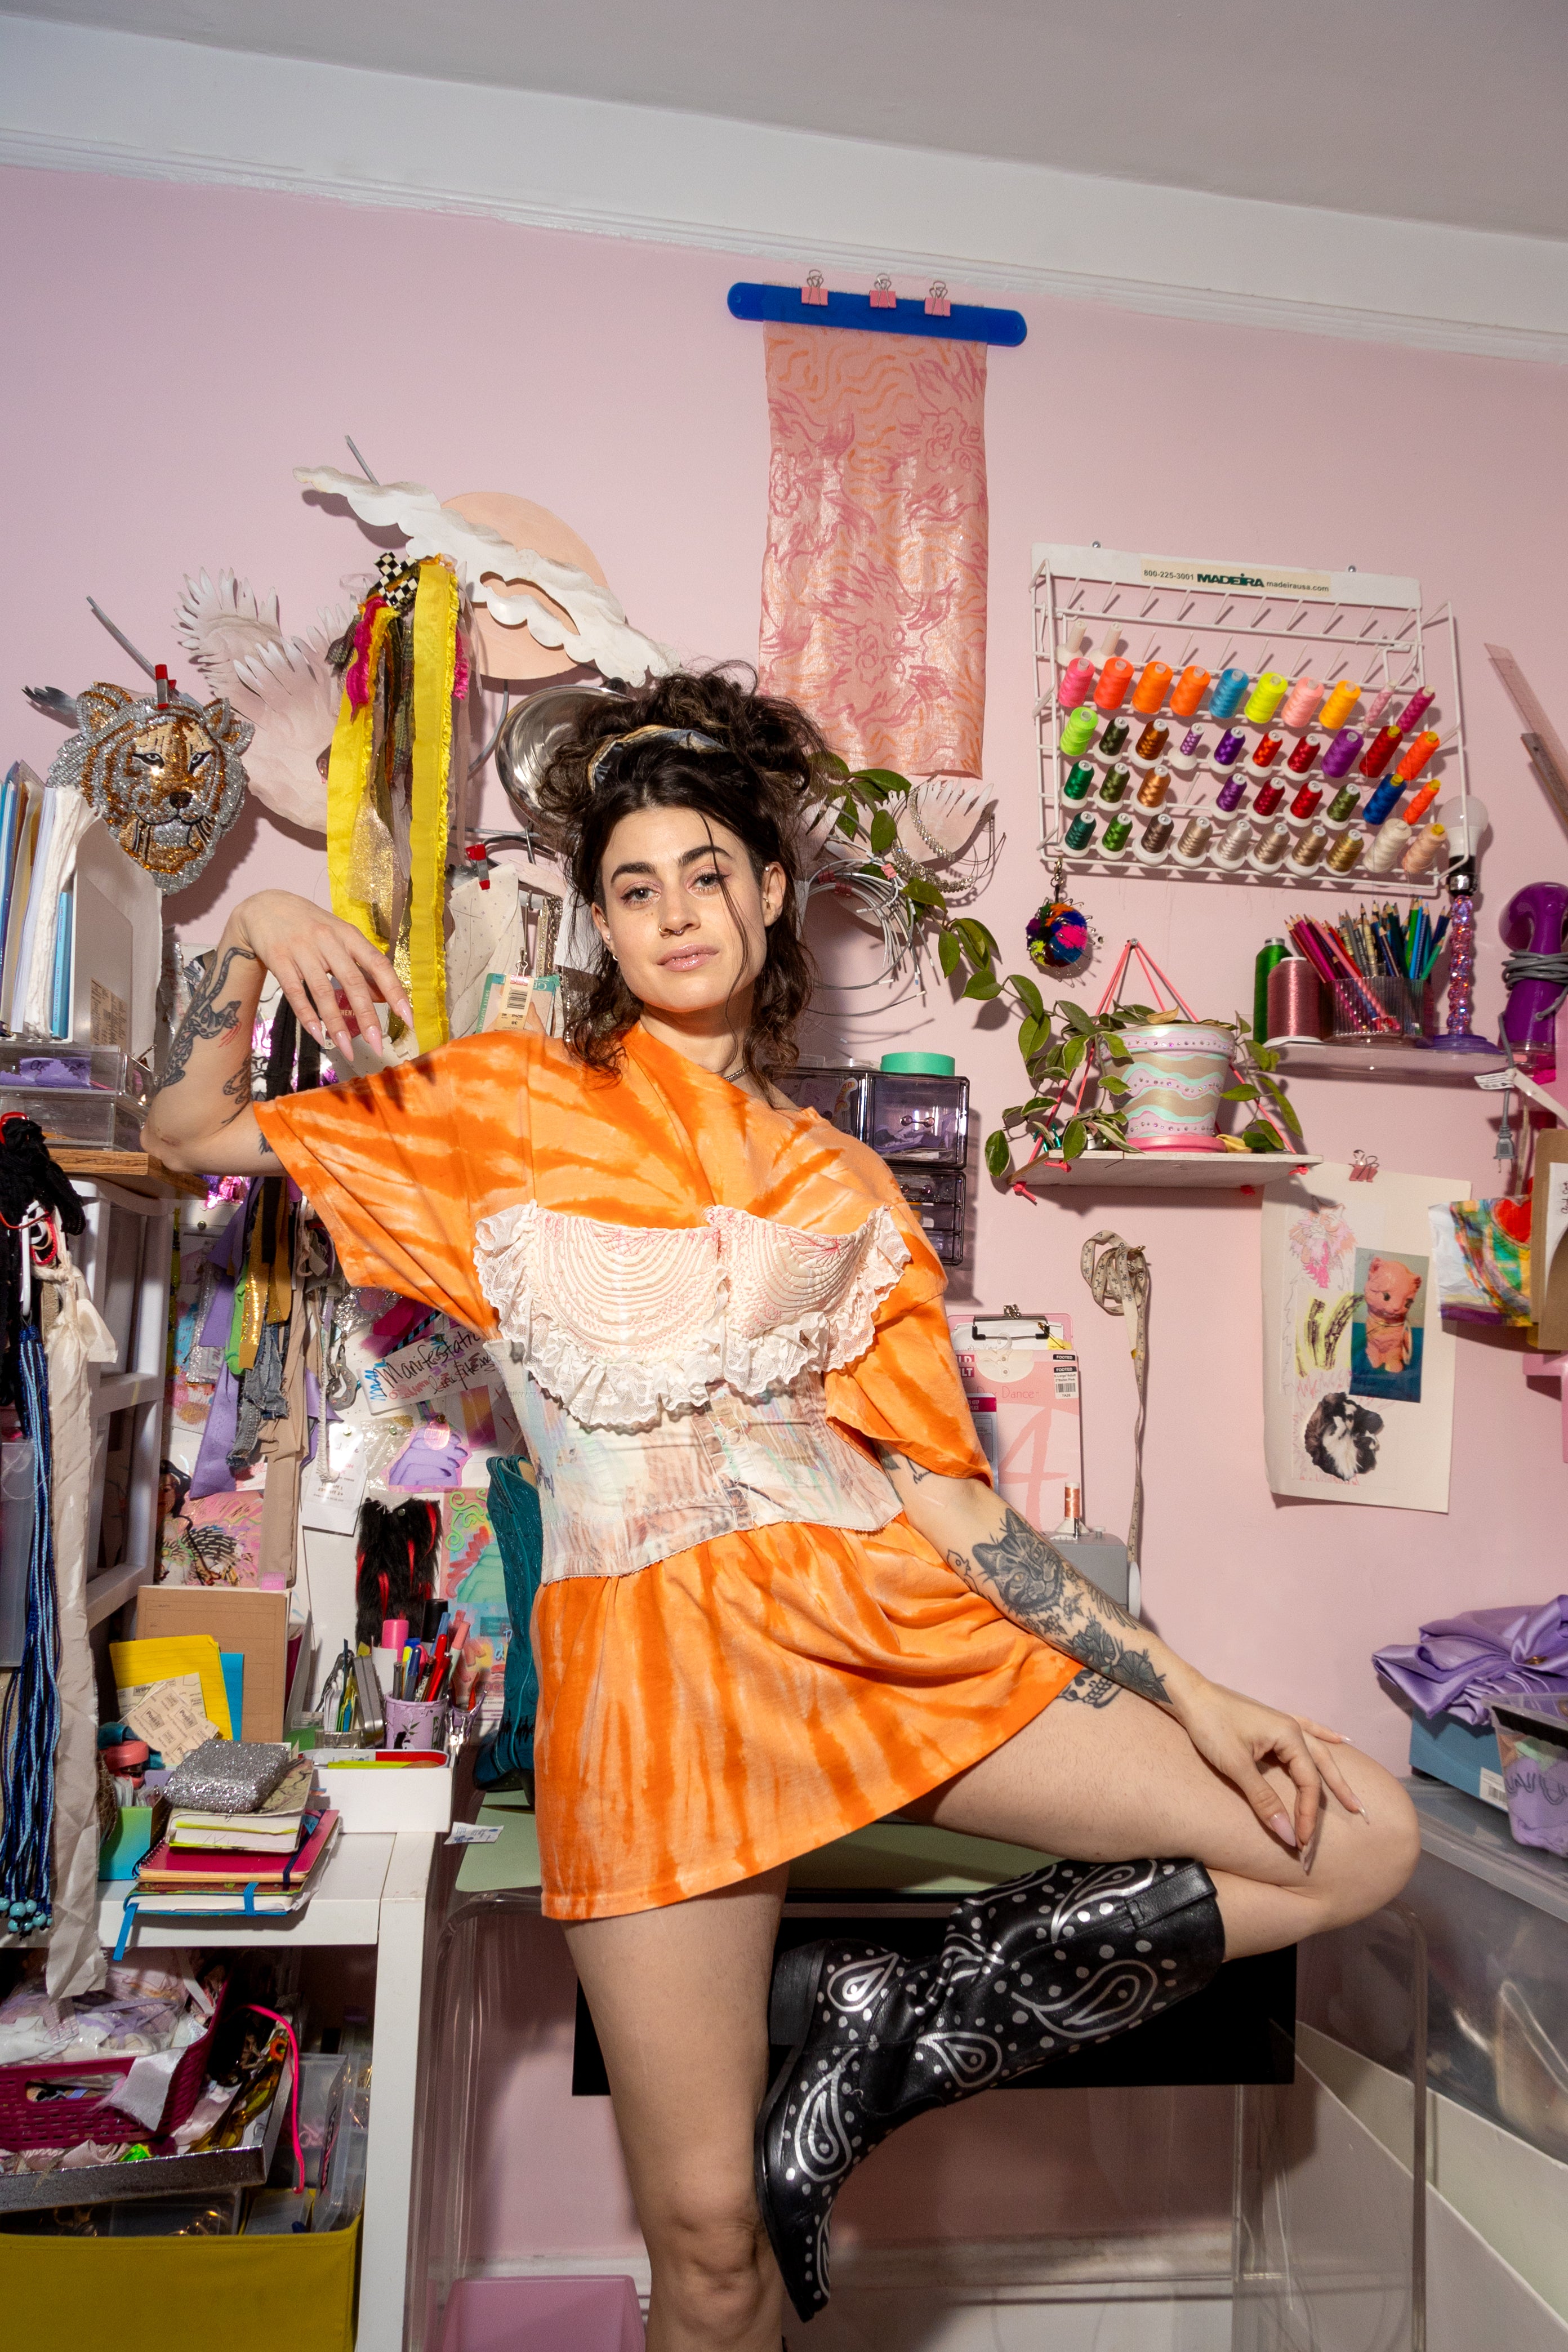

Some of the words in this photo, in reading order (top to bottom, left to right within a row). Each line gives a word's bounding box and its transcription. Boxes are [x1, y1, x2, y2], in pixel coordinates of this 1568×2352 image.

[1143, 569, 1194, 581] 800-225-3001
[1266, 580, 1330, 592] madeirausa.com
[1002, 1386, 1035, 1399] Dance
[146, 1710, 161, 1727] Post-it
[180, 1709, 195, 1726] Post-it
